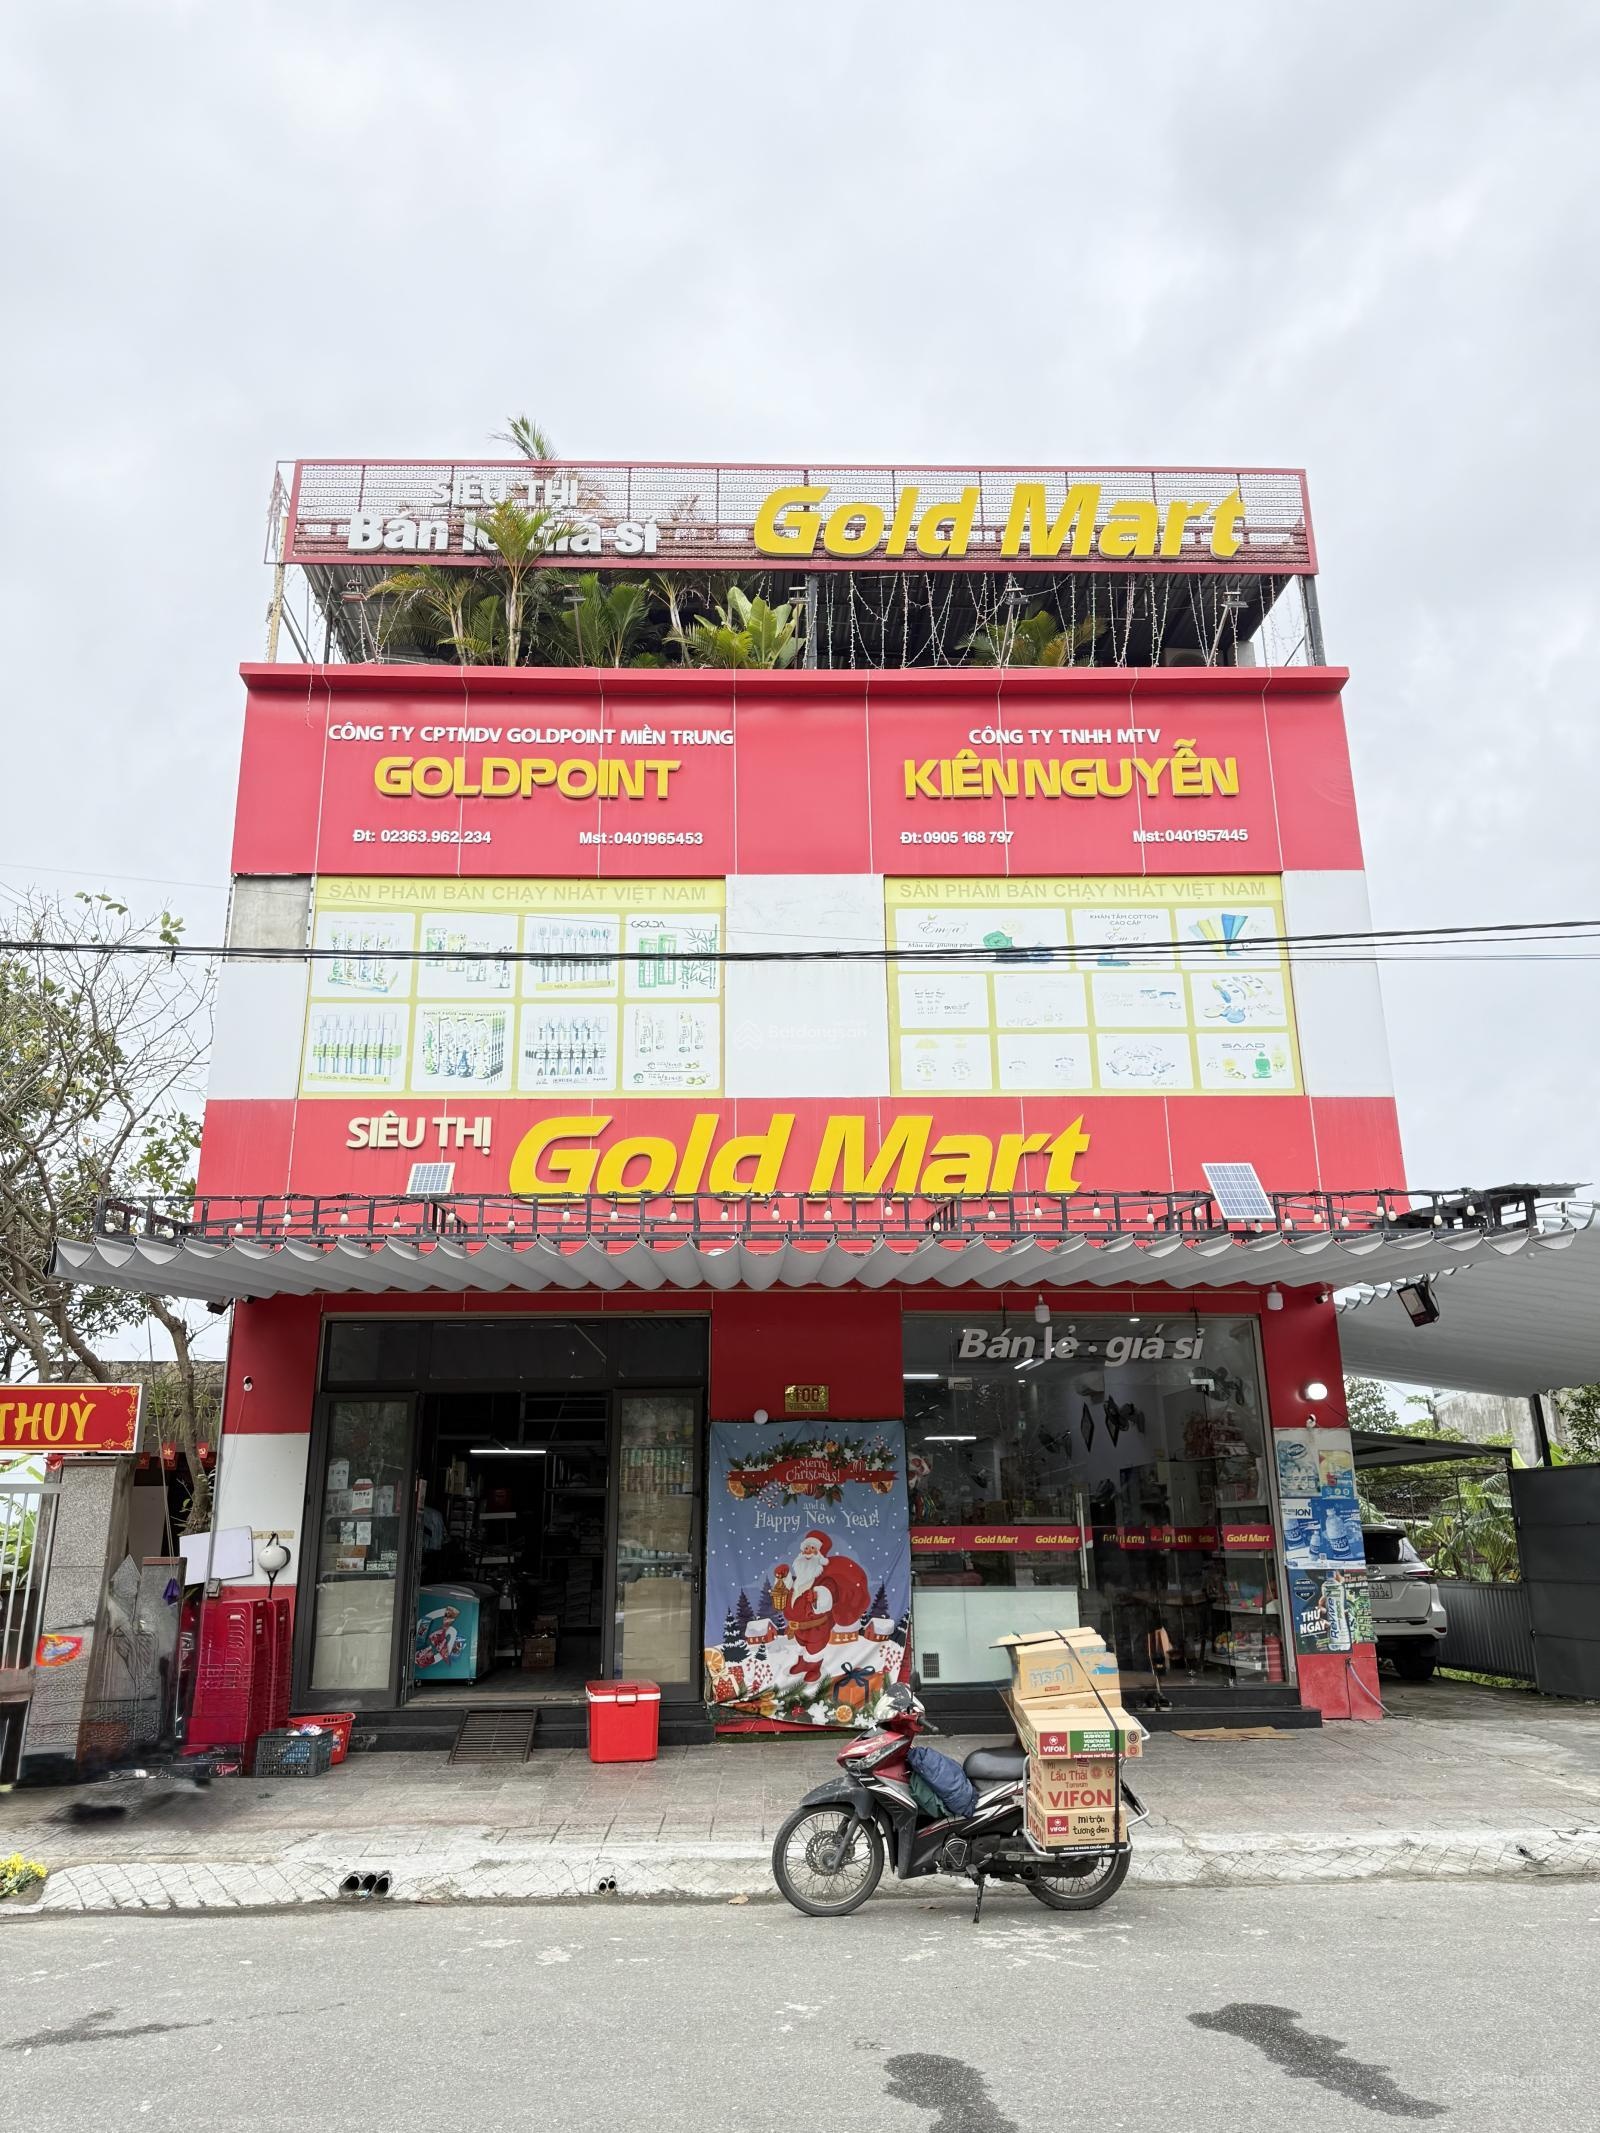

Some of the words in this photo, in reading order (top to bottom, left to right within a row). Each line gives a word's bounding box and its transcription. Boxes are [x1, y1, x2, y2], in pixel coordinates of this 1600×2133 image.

[754, 485, 982, 559] Gold
[1000, 483, 1247, 560] Mart
[348, 511, 449, 551] Bán
[328, 722, 383, 743] CÔNG
[389, 726, 415, 743] TY
[420, 726, 502, 744] CPTMDV
[507, 728, 616, 745] GOLDPOINT
[620, 723, 666, 746] MIỀN
[671, 730, 734, 746] TRUNG
[969, 725, 1023, 745] CÔNG
[1028, 730, 1053, 744] TY
[1059, 730, 1111, 744] TNHH
[1117, 729, 1160, 744] MTV
[373, 756, 682, 799] GOLDPOINT
[352, 829, 377, 844] Đt:
[380, 830, 492, 844] 02363.962.234
[962, 831, 986, 844] 168
[988, 831, 1014, 844] 797
[492, 886, 547, 904] CHẠY
[663, 887, 706, 901] NAM
[1053, 883, 1108, 901] CHẠY
[1222, 881, 1266, 897] NAM
[345, 1111, 426, 1149] SIÊU
[433, 1116, 493, 1155] THỊ
[508, 1113, 796, 1203] Gold
[808, 1112, 1093, 1203] Mart
[959, 1328, 1035, 1359] Bán
[1044, 1326, 1081, 1360] lẻ
[1104, 1325, 1164, 1367] giá
[1172, 1328, 1206, 1359] sỉ
[786, 1466, 841, 1482] Christmas!
[795, 1459, 829, 1472] Merry
[803, 1500, 819, 1510] and
[820, 1503, 826, 1511] a
[1295, 1508, 1311, 1516] ION
[753, 1510, 801, 1533] Happy
[805, 1510, 837, 1528] New
[841, 1508, 881, 1528] Year!
[912, 1536, 933, 1545] Gold
[934, 1536, 955, 1545] Mart
[974, 1536, 996, 1545] Gold
[997, 1536, 1018, 1545] Mart
[1035, 1536, 1057, 1545] Gold
[1058, 1536, 1079, 1545] Mart
[1226, 1533, 1248, 1543] Gold
[1249, 1533, 1271, 1543] Mart
[1299, 1619, 1326, 1635] NGAY
[1328, 1597, 1339, 1639] Revive
[1043, 1745, 1065, 1753] VIFON
[1048, 1789, 1112, 1808] VIFON
